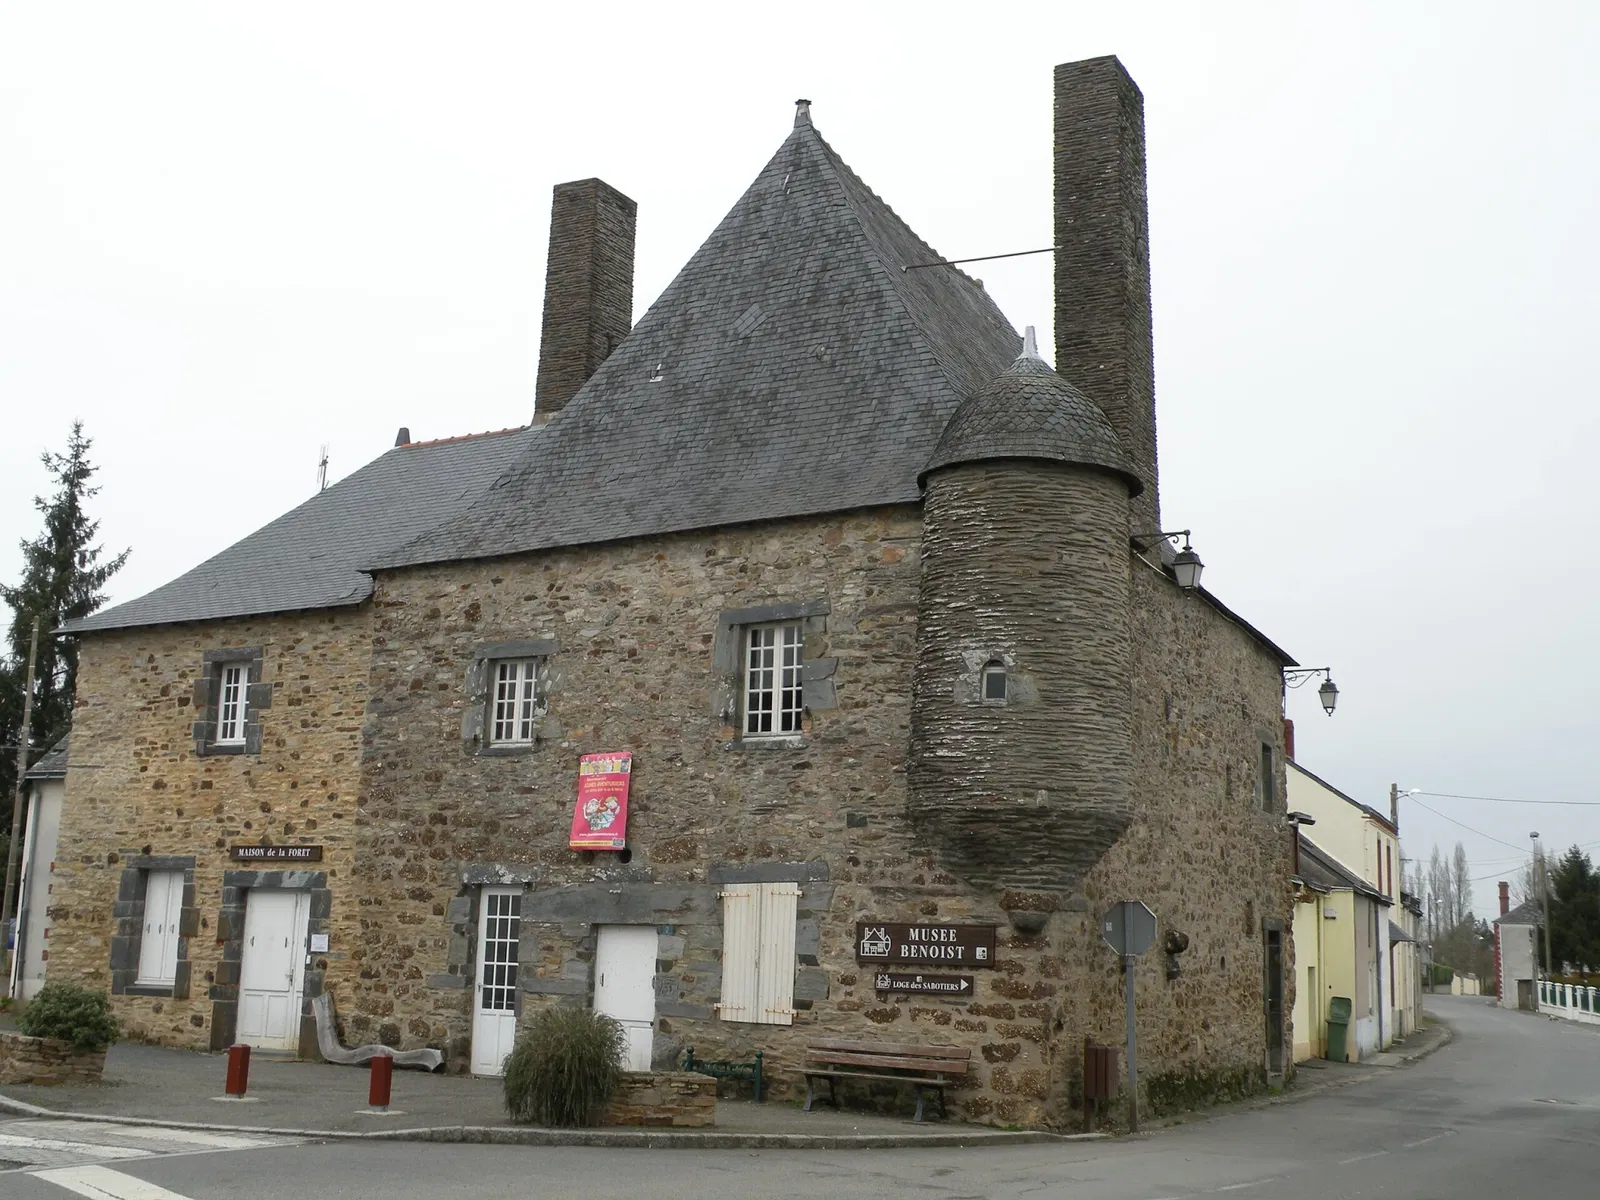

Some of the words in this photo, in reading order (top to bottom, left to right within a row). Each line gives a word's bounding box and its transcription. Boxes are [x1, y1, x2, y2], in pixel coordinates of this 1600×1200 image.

[238, 848, 265, 857] MAISON
[267, 848, 276, 857] de
[279, 848, 286, 857] la
[288, 848, 311, 857] FORET
[908, 928, 957, 942] MUSEE
[900, 944, 965, 959] BENOIST
[893, 981, 910, 989] LOGE
[910, 981, 922, 989] des
[922, 982, 959, 991] SABOTIERS
